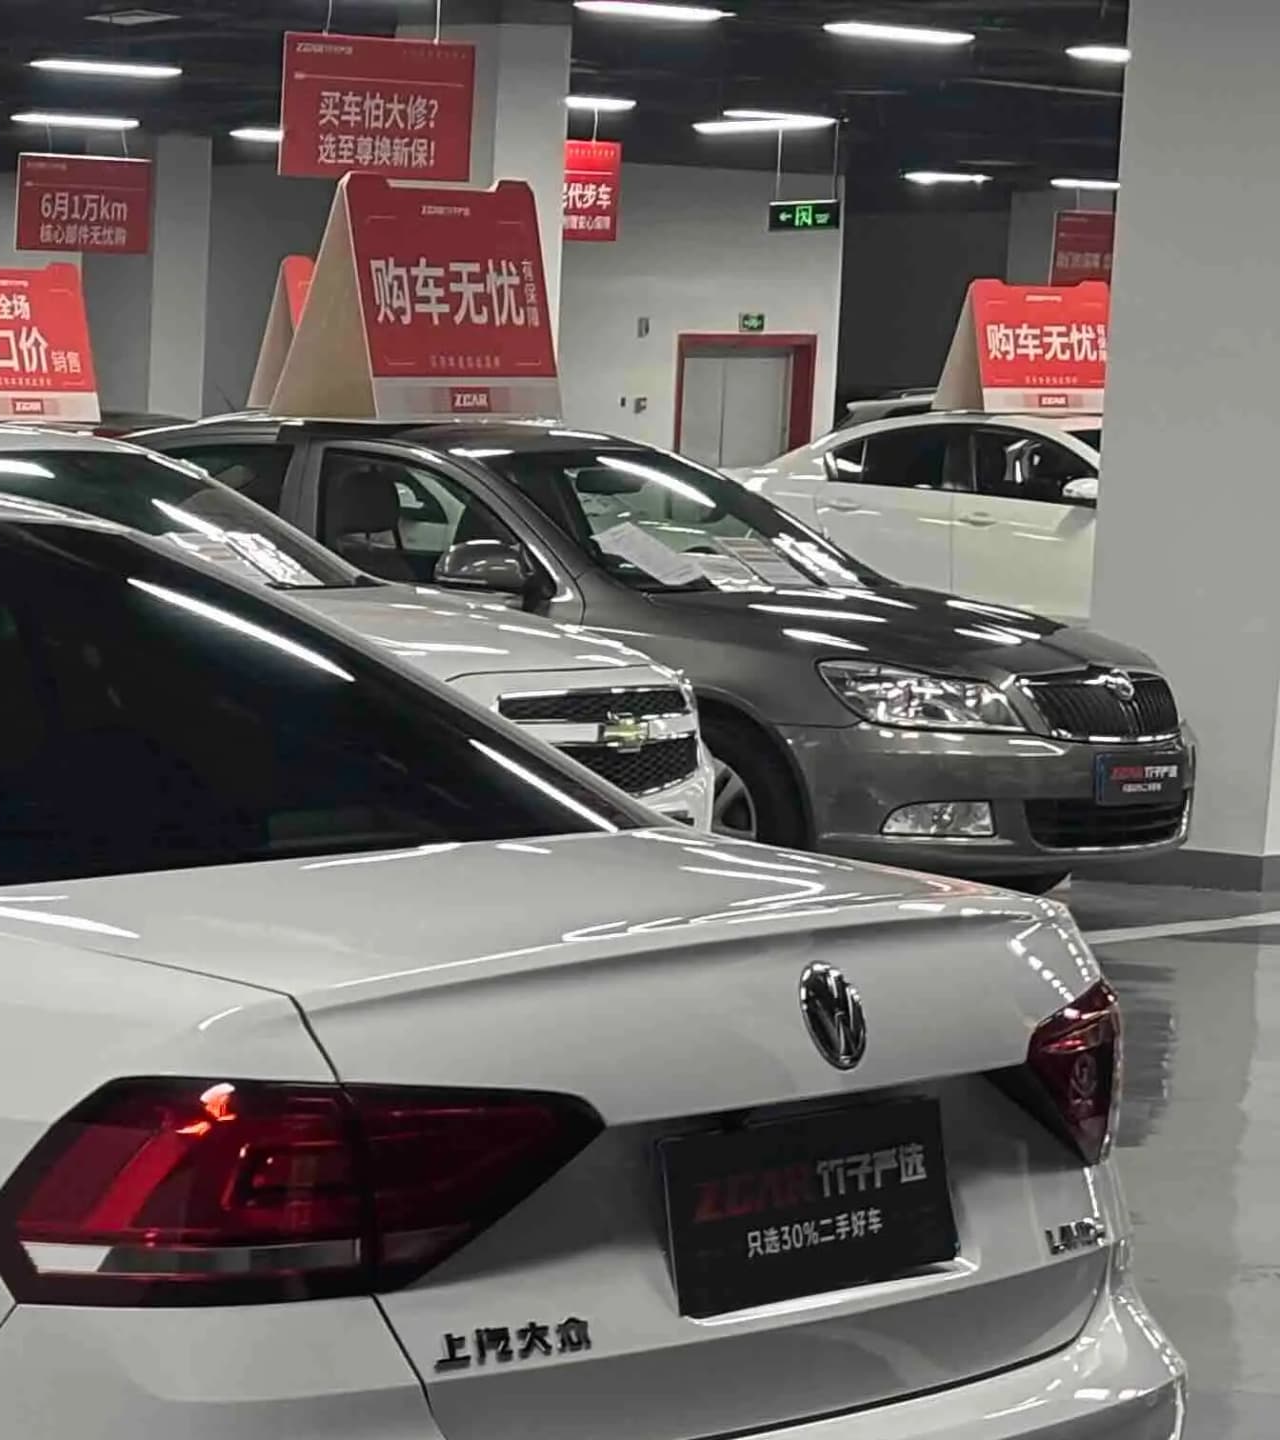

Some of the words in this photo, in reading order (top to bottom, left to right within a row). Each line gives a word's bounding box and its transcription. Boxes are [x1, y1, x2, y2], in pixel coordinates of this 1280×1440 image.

[40, 192, 128, 222] 6月1万km
[369, 256, 526, 328] 购车无忧
[986, 323, 1098, 362] 购车无忧
[50, 351, 82, 374] 销售
[454, 393, 489, 408] ZCAR
[816, 1142, 928, 1198] 竹子严选
[747, 1206, 883, 1259] 只选30%二手好车
